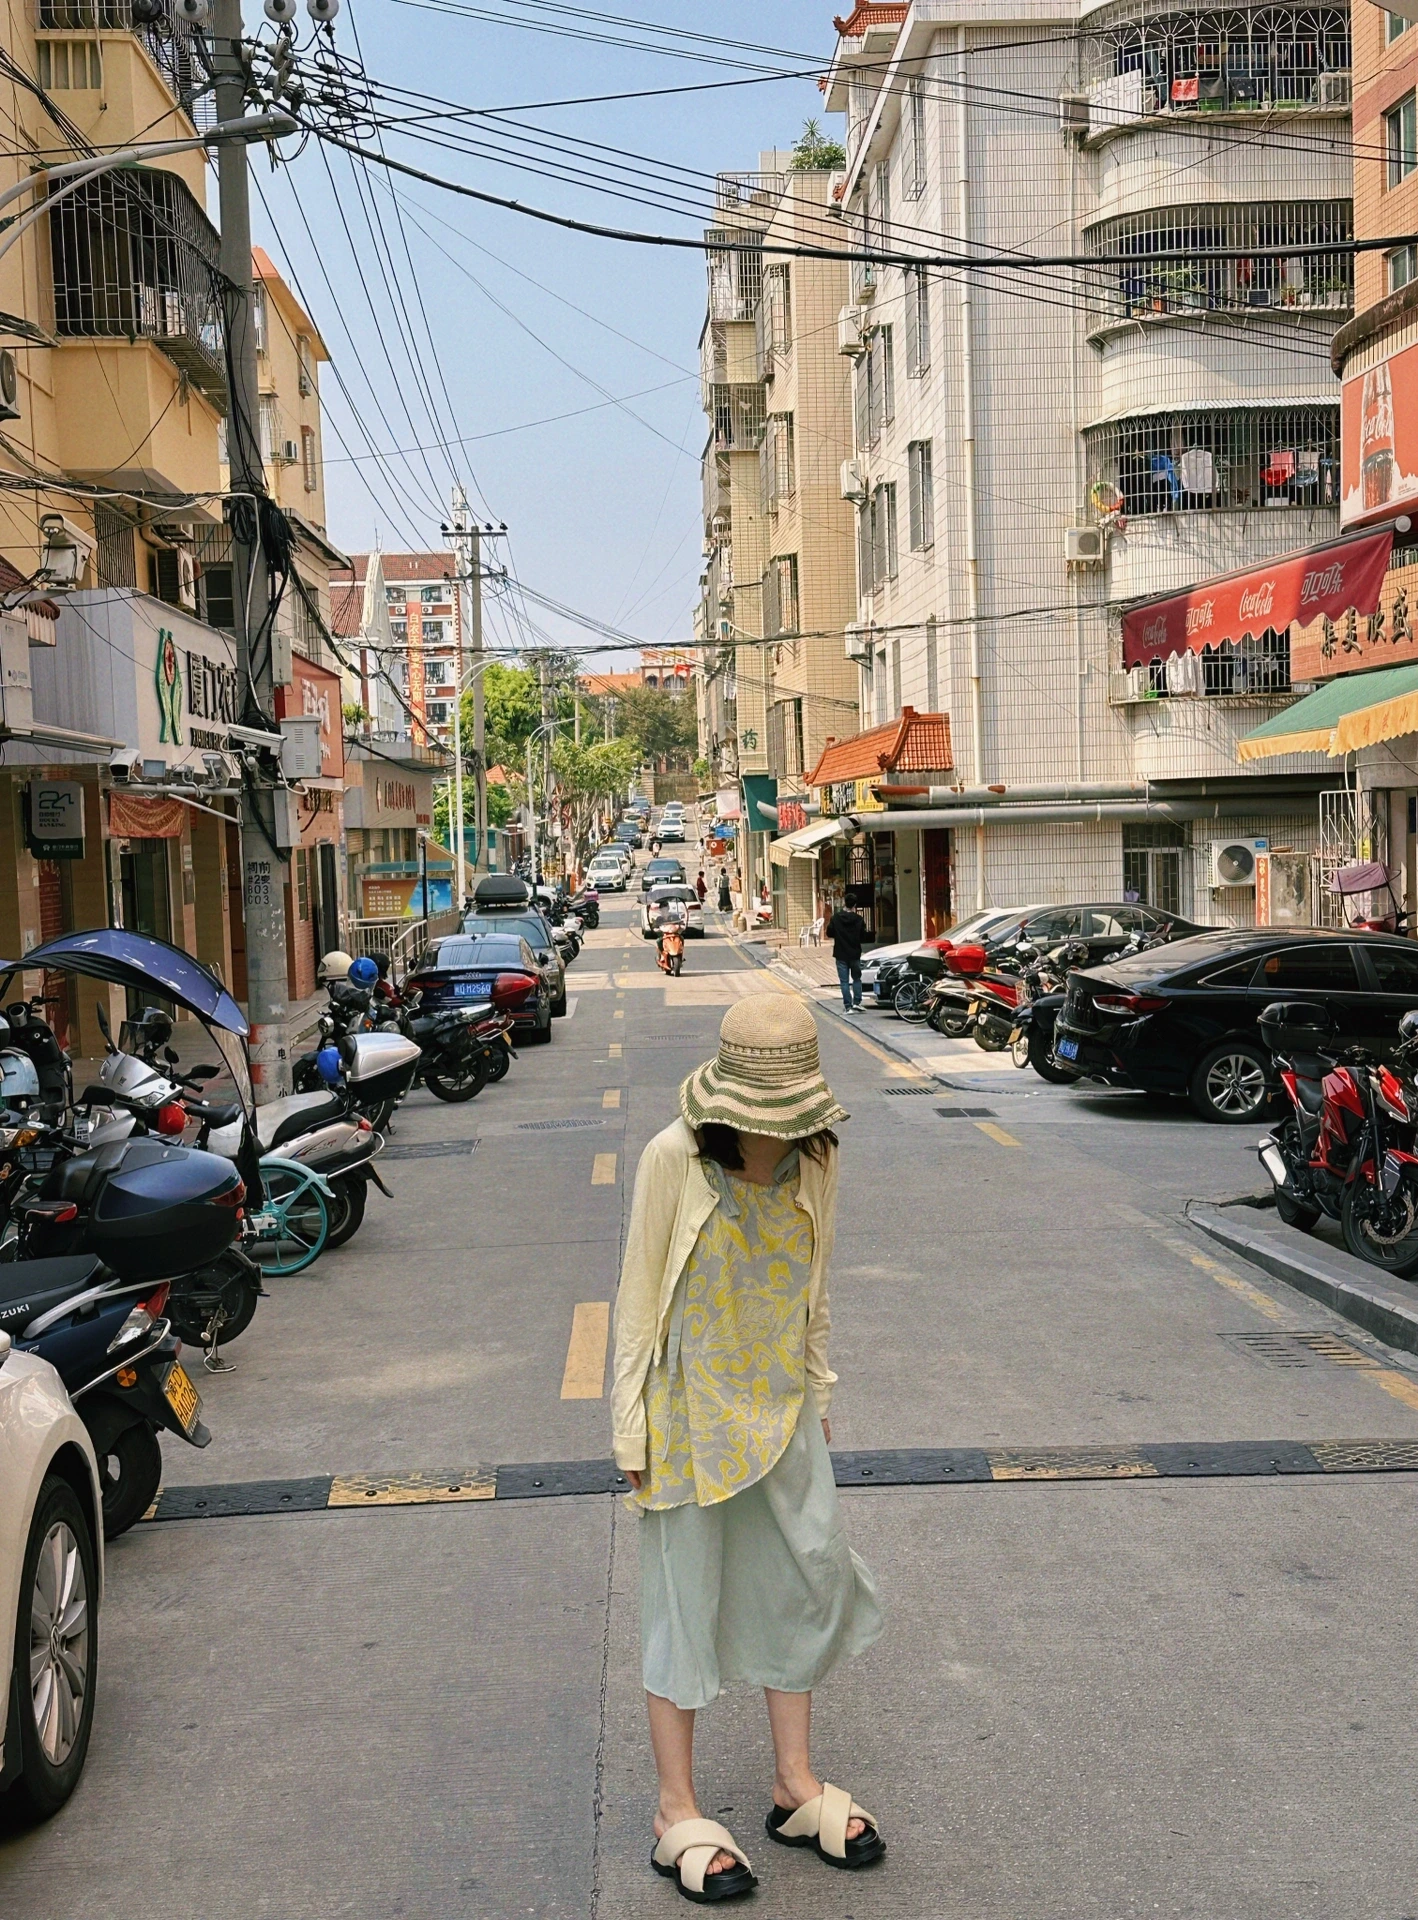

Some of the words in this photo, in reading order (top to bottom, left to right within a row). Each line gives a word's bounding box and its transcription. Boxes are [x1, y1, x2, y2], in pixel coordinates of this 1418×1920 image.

[1300, 561, 1348, 605] 可口可乐
[1238, 580, 1276, 622] Coca-Cola
[1185, 598, 1216, 635] 可口可乐
[741, 729, 758, 750] 药
[38, 790, 75, 812] 24
[248, 884, 269, 895] B03
[248, 895, 270, 905] C03
[0, 1303, 30, 1320] ZUKI
[175, 1380, 198, 1428] HA026
